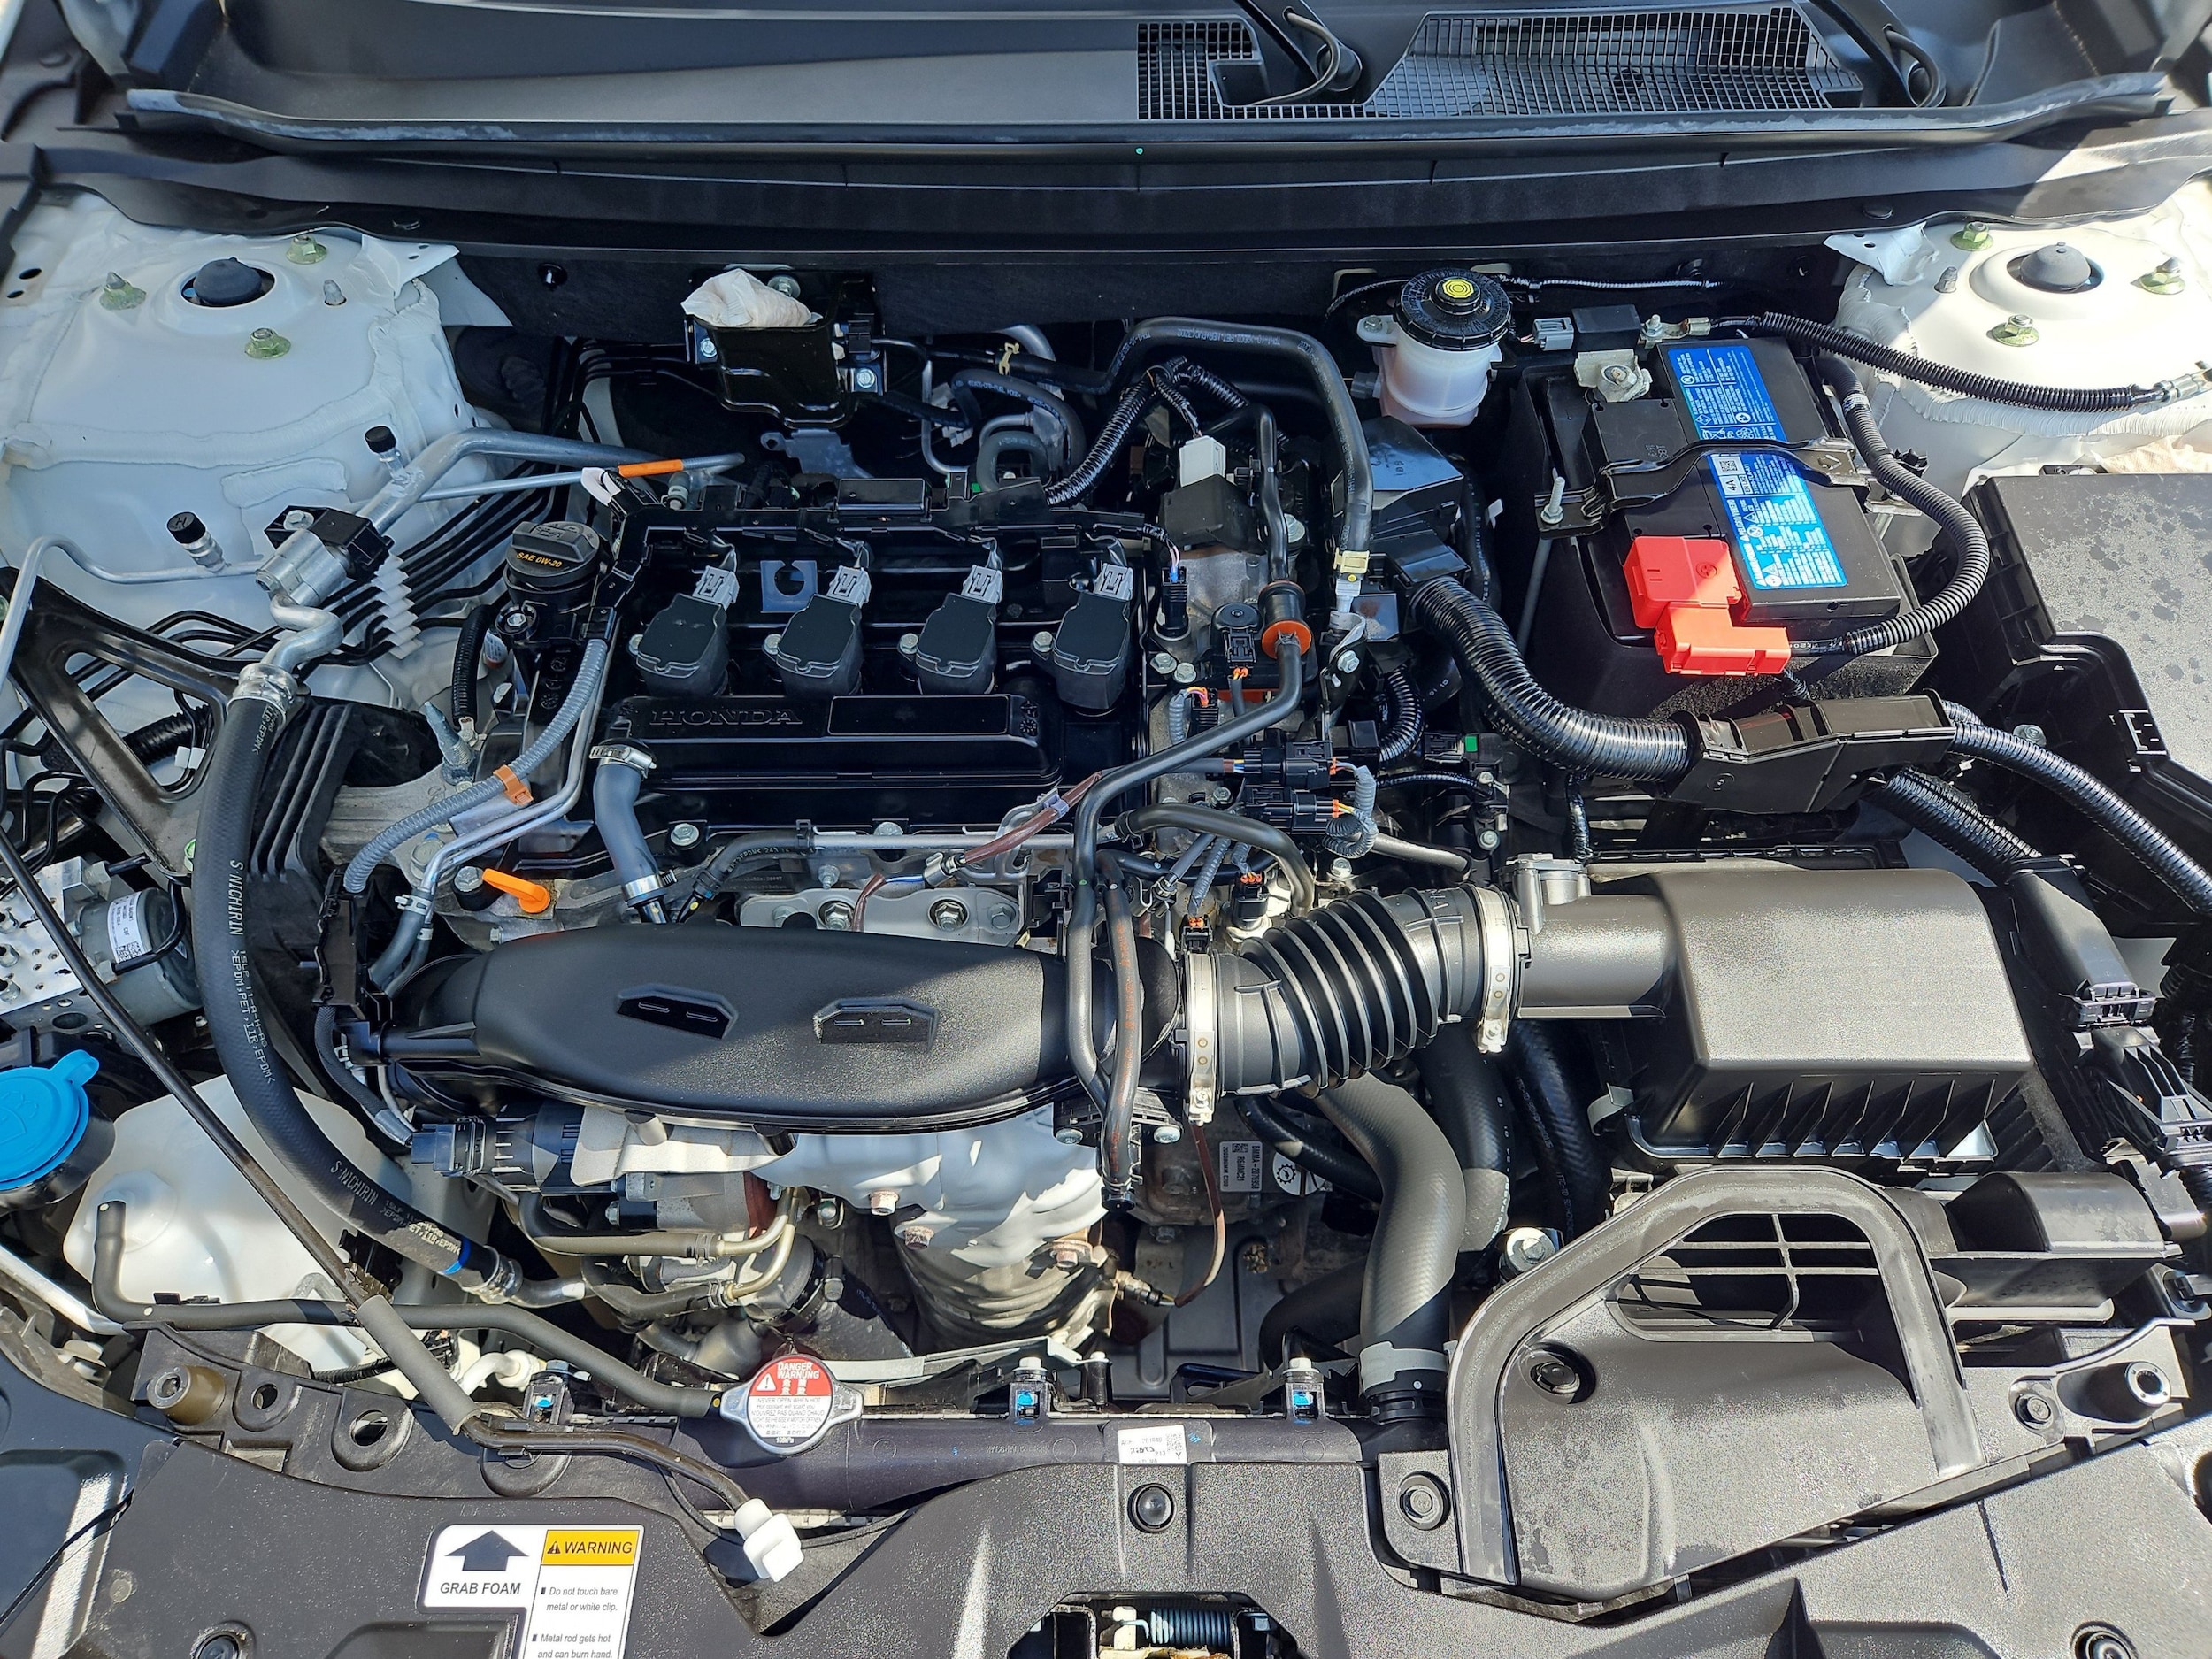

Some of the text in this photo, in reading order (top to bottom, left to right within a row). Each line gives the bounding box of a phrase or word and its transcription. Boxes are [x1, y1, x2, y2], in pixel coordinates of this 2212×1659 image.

[1726, 479, 1737, 492] 4A
[516, 552, 563, 568] SAE 0W-20
[649, 709, 803, 726] HONDA
[778, 1362, 813, 1371] DANGER
[778, 1371, 820, 1379] WARNUNG
[565, 1541, 633, 1554] WARNING
[440, 1582, 521, 1594] GRAB FOAM
[549, 1586, 561, 1595] Do
[577, 1586, 598, 1595] touch
[600, 1586, 618, 1595] bare
[546, 1602, 569, 1611] metal
[580, 1602, 601, 1611] white
[602, 1602, 618, 1613] clip.
[541, 1633, 611, 1644] Metal rod gets hot
[537, 1649, 554, 1659] and
[571, 1649, 589, 1659] burn
[590, 1649, 613, 1659] hand.
